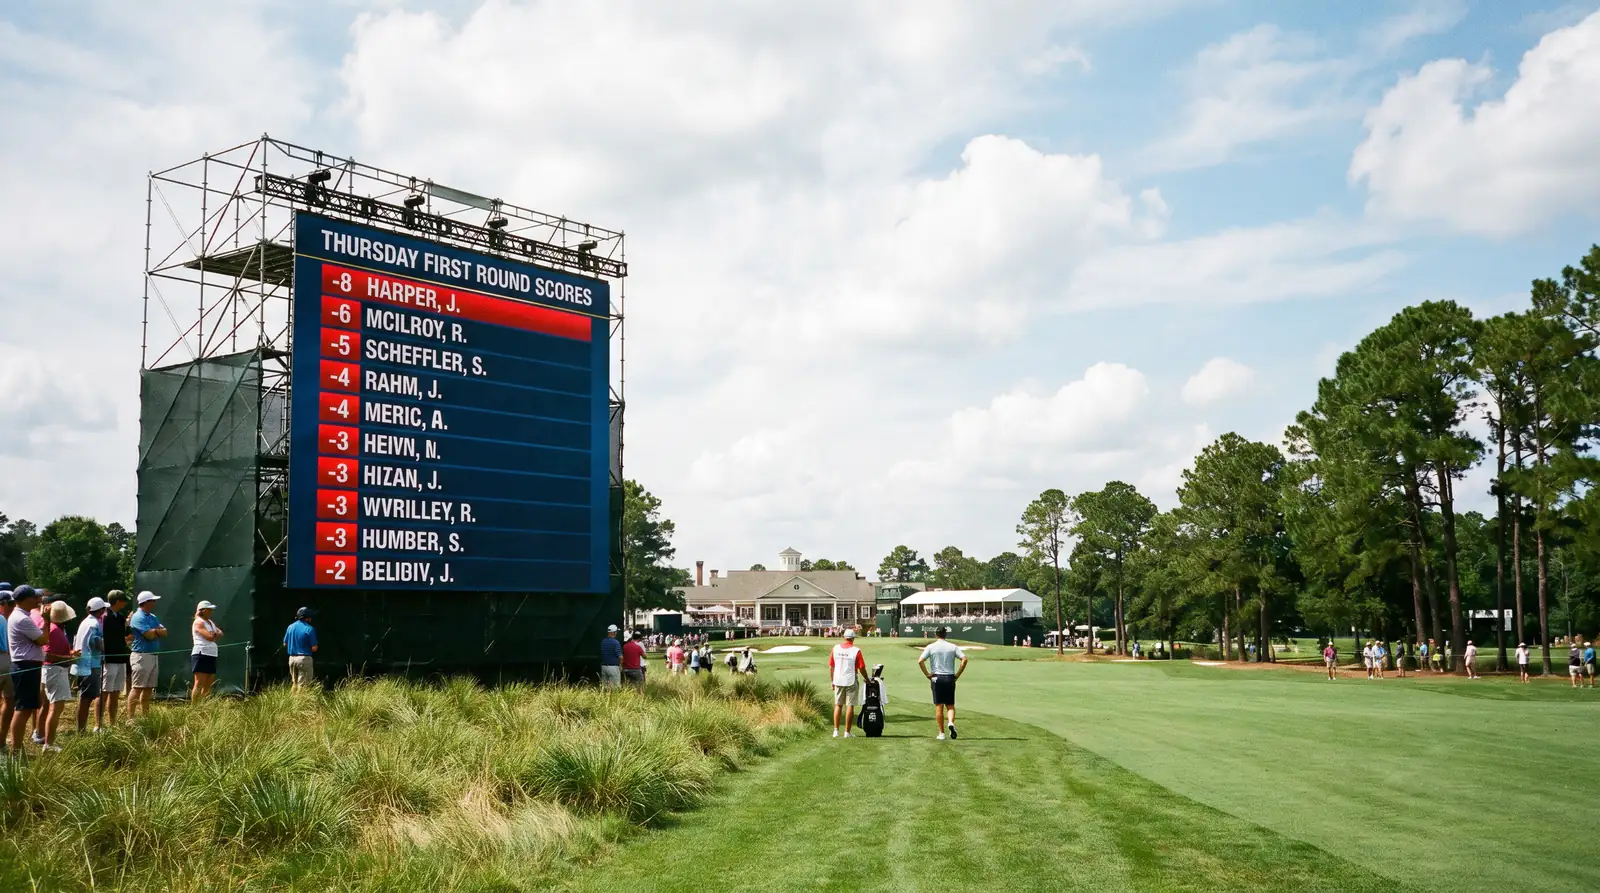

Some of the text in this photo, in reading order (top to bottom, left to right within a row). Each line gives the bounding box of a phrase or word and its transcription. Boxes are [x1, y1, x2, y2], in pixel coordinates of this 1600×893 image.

[321, 229, 593, 307] THURSDAY FIRST ROUND SCORES
[332, 272, 461, 313] -8 HARPER, J.
[331, 303, 467, 344] -6 MCILROY, R.
[330, 334, 487, 377] -5 SCHEFFLER, S.
[330, 367, 442, 401] -4 RAHM, J.
[329, 399, 448, 432] -4 MERIC, A.
[328, 431, 441, 462] -3 HEIVN, N.
[328, 463, 442, 493] -3 HIZAN, J.
[327, 495, 476, 525] -3 WVRILLEY, R.
[326, 527, 464, 555] -3 HUMBER, S.
[326, 560, 346, 580] -2
[439, 563, 454, 583] J.
